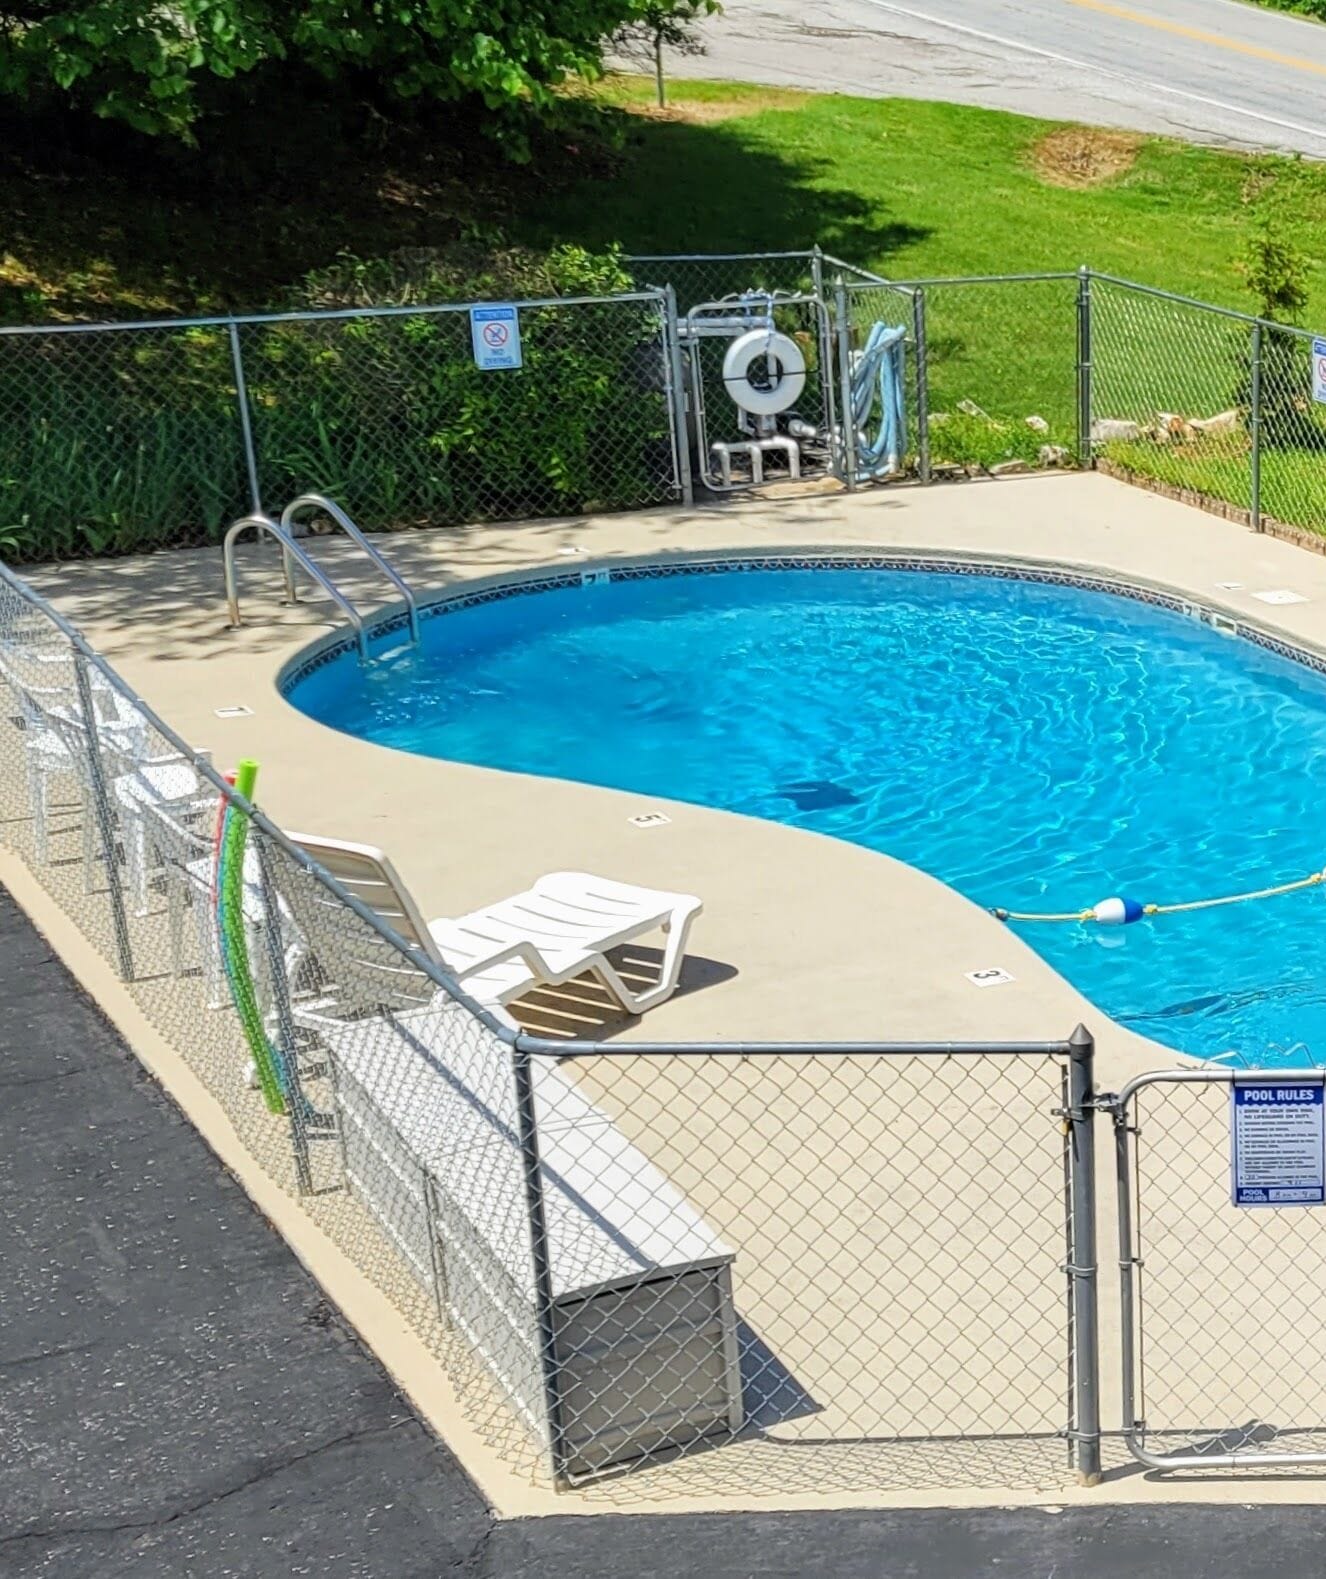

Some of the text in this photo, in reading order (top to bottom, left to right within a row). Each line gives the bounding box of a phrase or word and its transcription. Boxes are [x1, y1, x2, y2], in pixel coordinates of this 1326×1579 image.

[585, 574, 596, 585] 7
[635, 814, 662, 822] 5
[973, 970, 1000, 979] 3
[1244, 1089, 1315, 1101] POOL RULES
